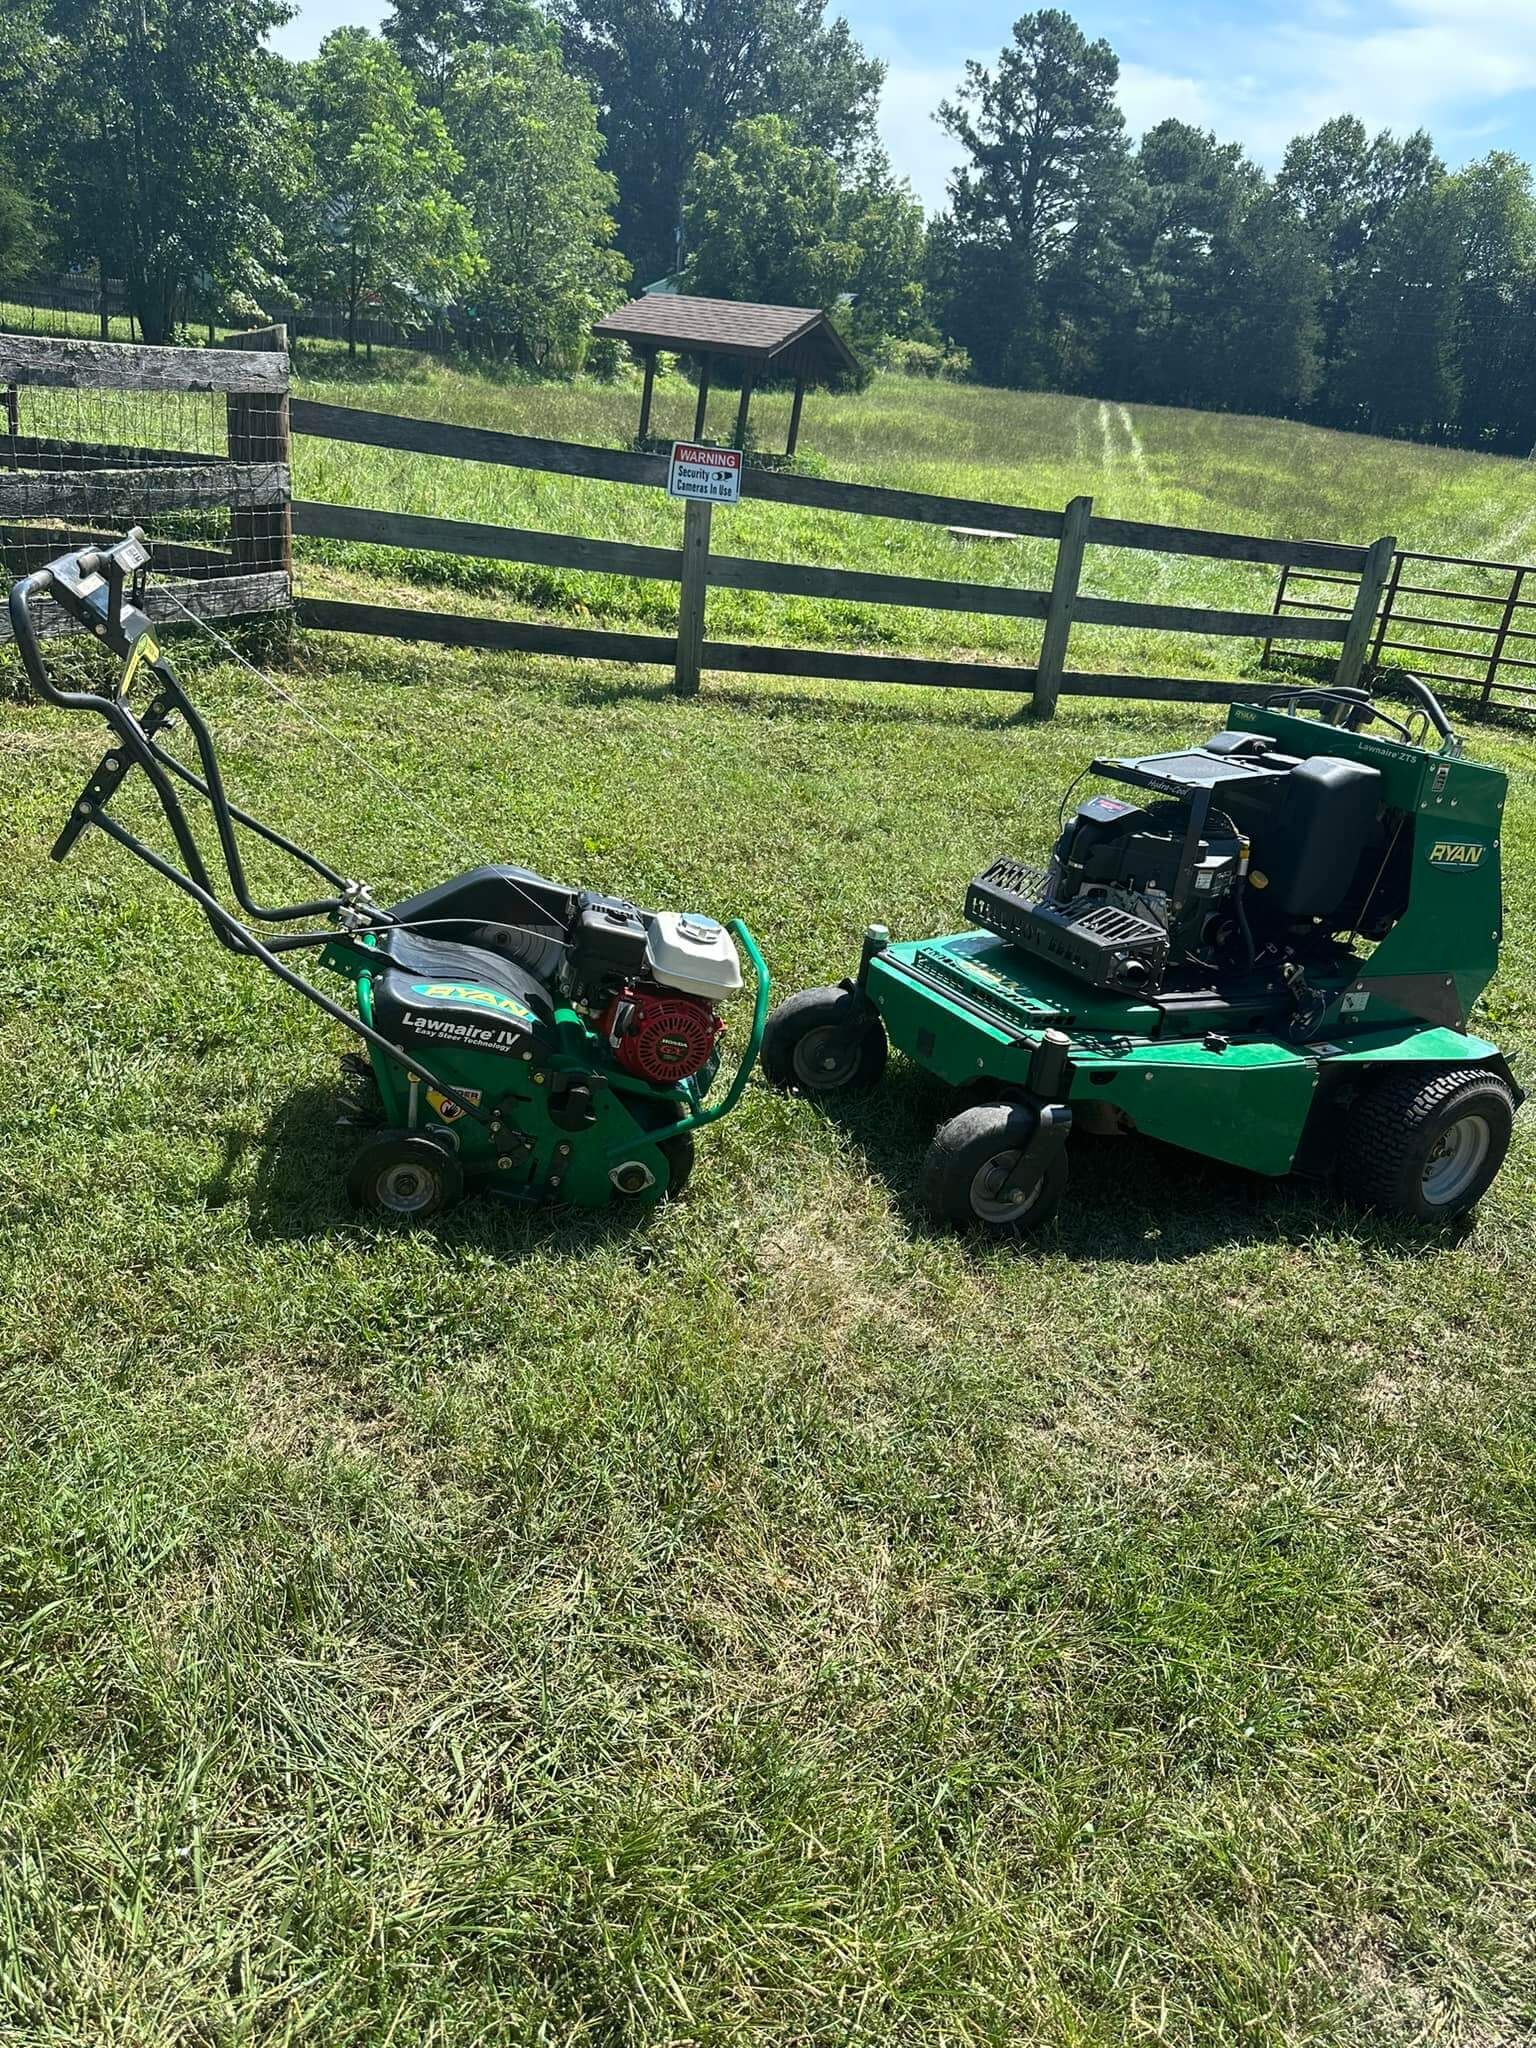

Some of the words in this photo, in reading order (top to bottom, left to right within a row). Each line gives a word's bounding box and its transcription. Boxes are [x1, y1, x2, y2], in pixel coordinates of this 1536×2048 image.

[680, 449, 735, 467] WARNING
[678, 465, 710, 482] Security
[677, 479, 708, 494] Cameras
[710, 484, 717, 495] In
[719, 484, 732, 497] Use
[1358, 741, 1397, 758] Lawnaire
[1398, 752, 1417, 764] ZTS
[1430, 844, 1483, 863] RYAN
[425, 985, 530, 1016] RYAN
[402, 1012, 494, 1041] Lawnaire
[497, 1030, 520, 1045] IV
[415, 1027, 437, 1038] Easy
[438, 1032, 461, 1041] Steer
[463, 1036, 512, 1053] Technology
[662, 1039, 688, 1048] HONDA
